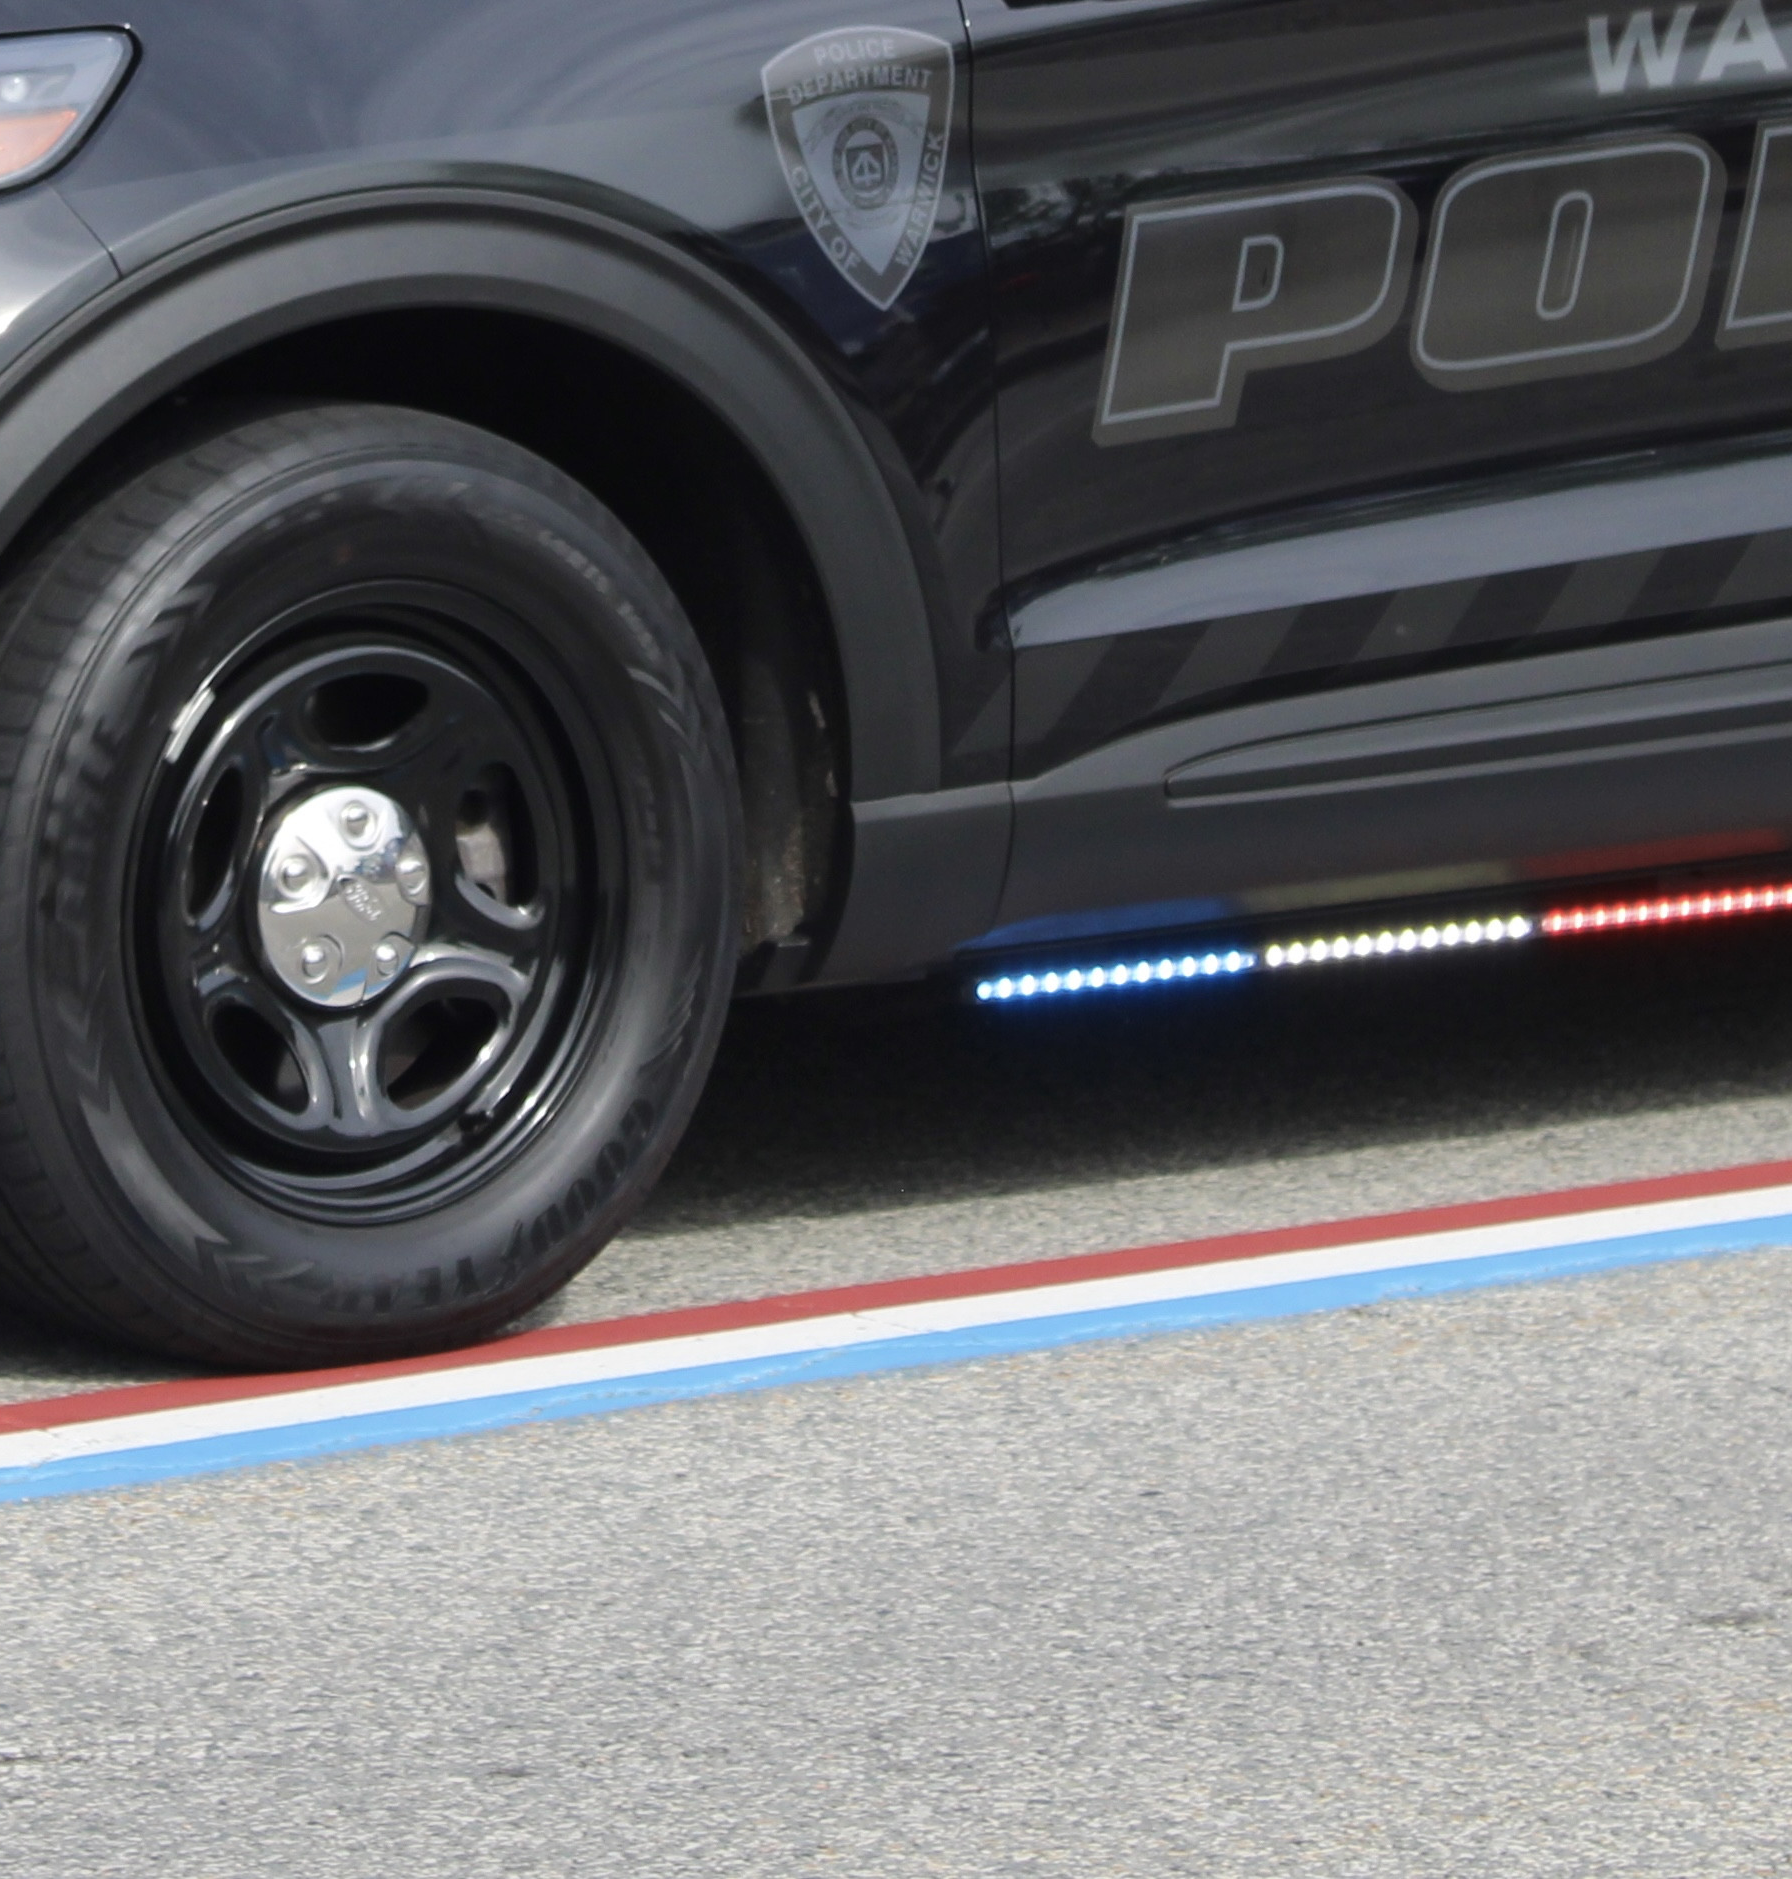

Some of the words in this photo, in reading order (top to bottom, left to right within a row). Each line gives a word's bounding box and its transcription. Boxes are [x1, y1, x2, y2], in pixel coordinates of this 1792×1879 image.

[788, 65, 933, 105] DEPARTMENT
[813, 37, 895, 65] POLICE
[791, 165, 831, 232] CITY
[828, 236, 862, 271] OF
[895, 132, 943, 267] WARWICK
